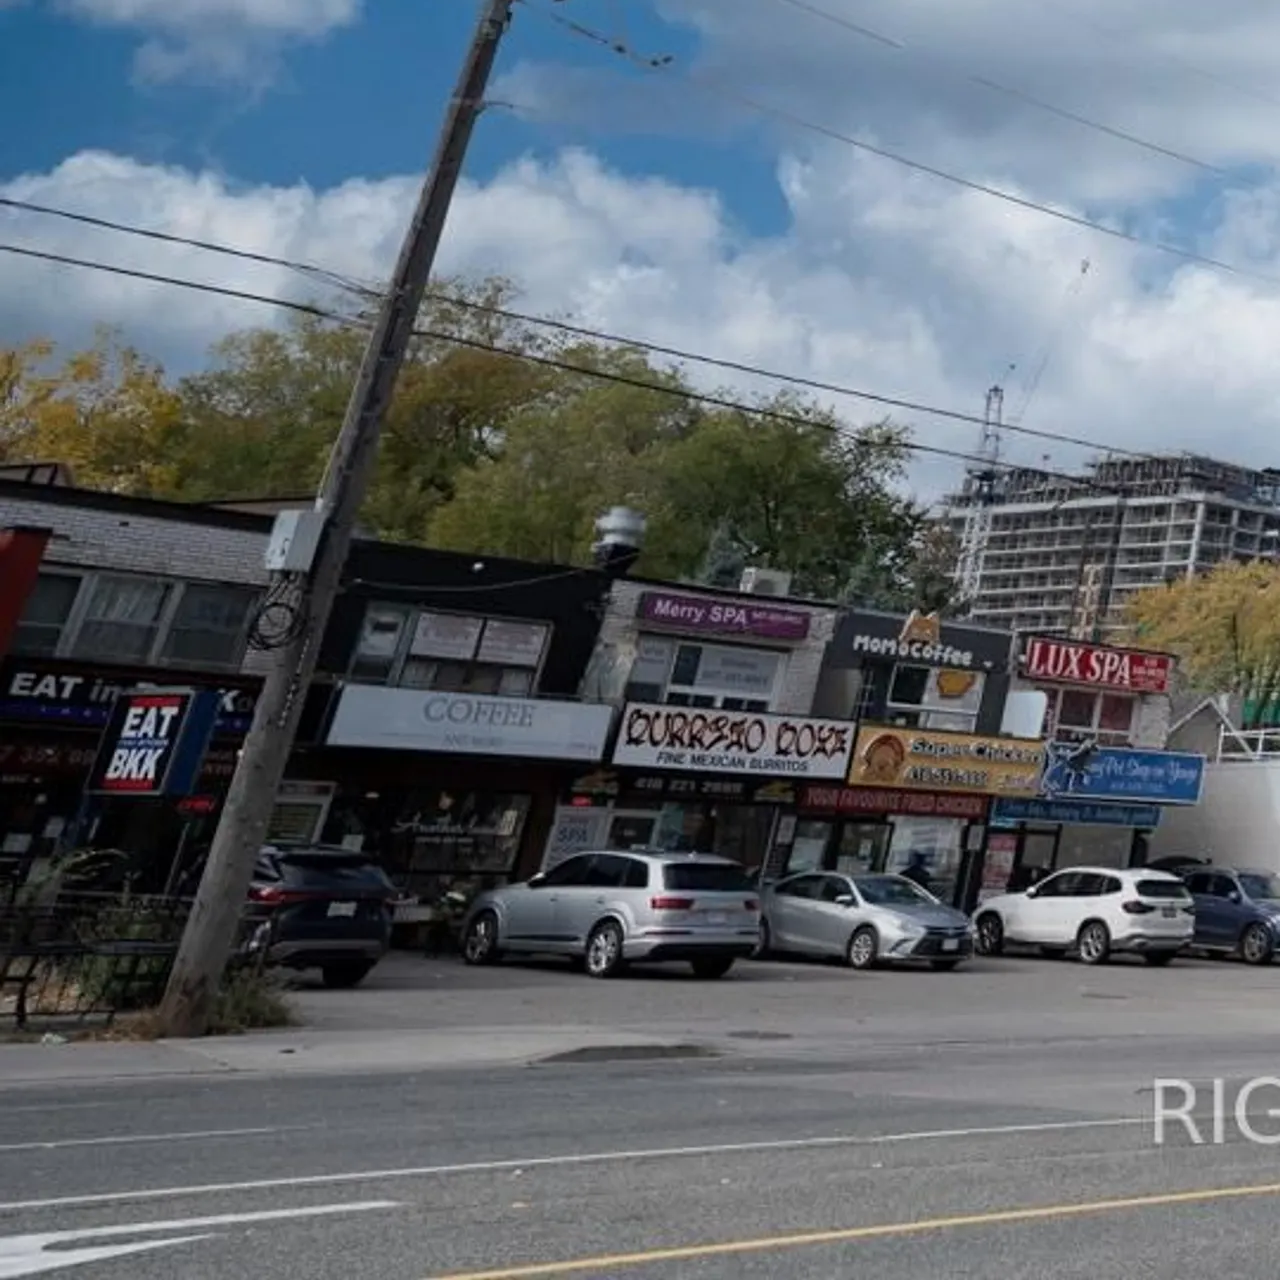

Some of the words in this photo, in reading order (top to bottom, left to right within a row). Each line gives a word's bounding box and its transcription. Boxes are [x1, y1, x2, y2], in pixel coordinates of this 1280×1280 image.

[654, 598, 705, 623] Merry
[708, 604, 749, 627] SPA
[1029, 641, 1085, 678] LUX
[1085, 650, 1132, 685] SPA
[8, 672, 84, 699] EAT
[121, 706, 180, 739] EAT
[423, 695, 537, 728] COFFEE
[105, 747, 164, 780] BKK
[655, 751, 686, 766] FINE
[689, 754, 746, 770] MEXICAN
[749, 757, 810, 773] BURRITOS
